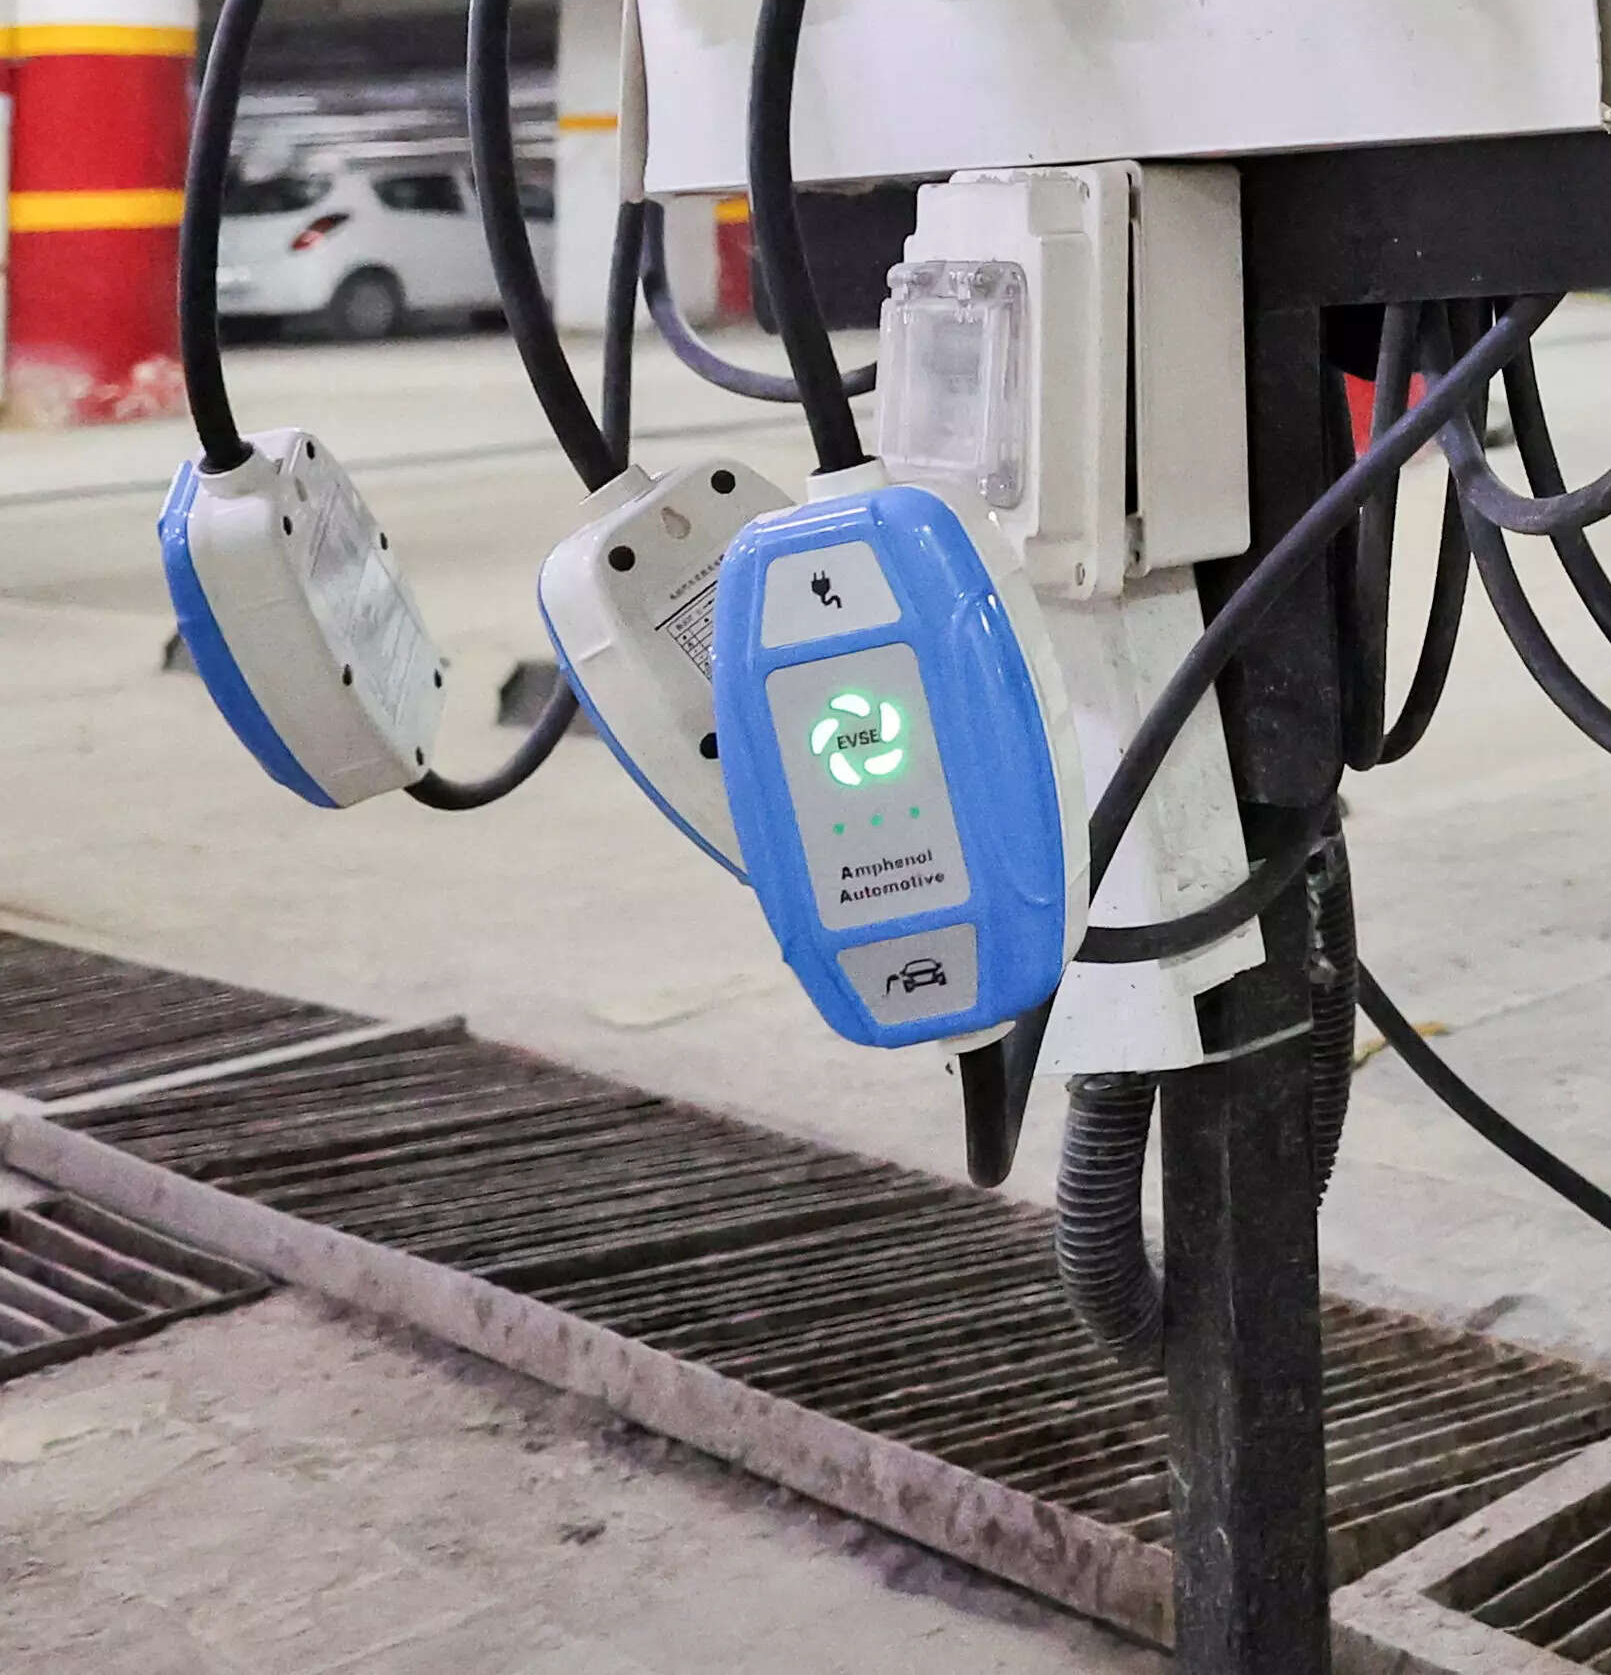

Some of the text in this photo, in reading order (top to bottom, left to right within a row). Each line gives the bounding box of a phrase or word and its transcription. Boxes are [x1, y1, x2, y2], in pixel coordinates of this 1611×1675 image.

[836, 728, 882, 750] EVSE
[840, 848, 934, 881] Amphenol
[839, 872, 945, 904] Automotive
